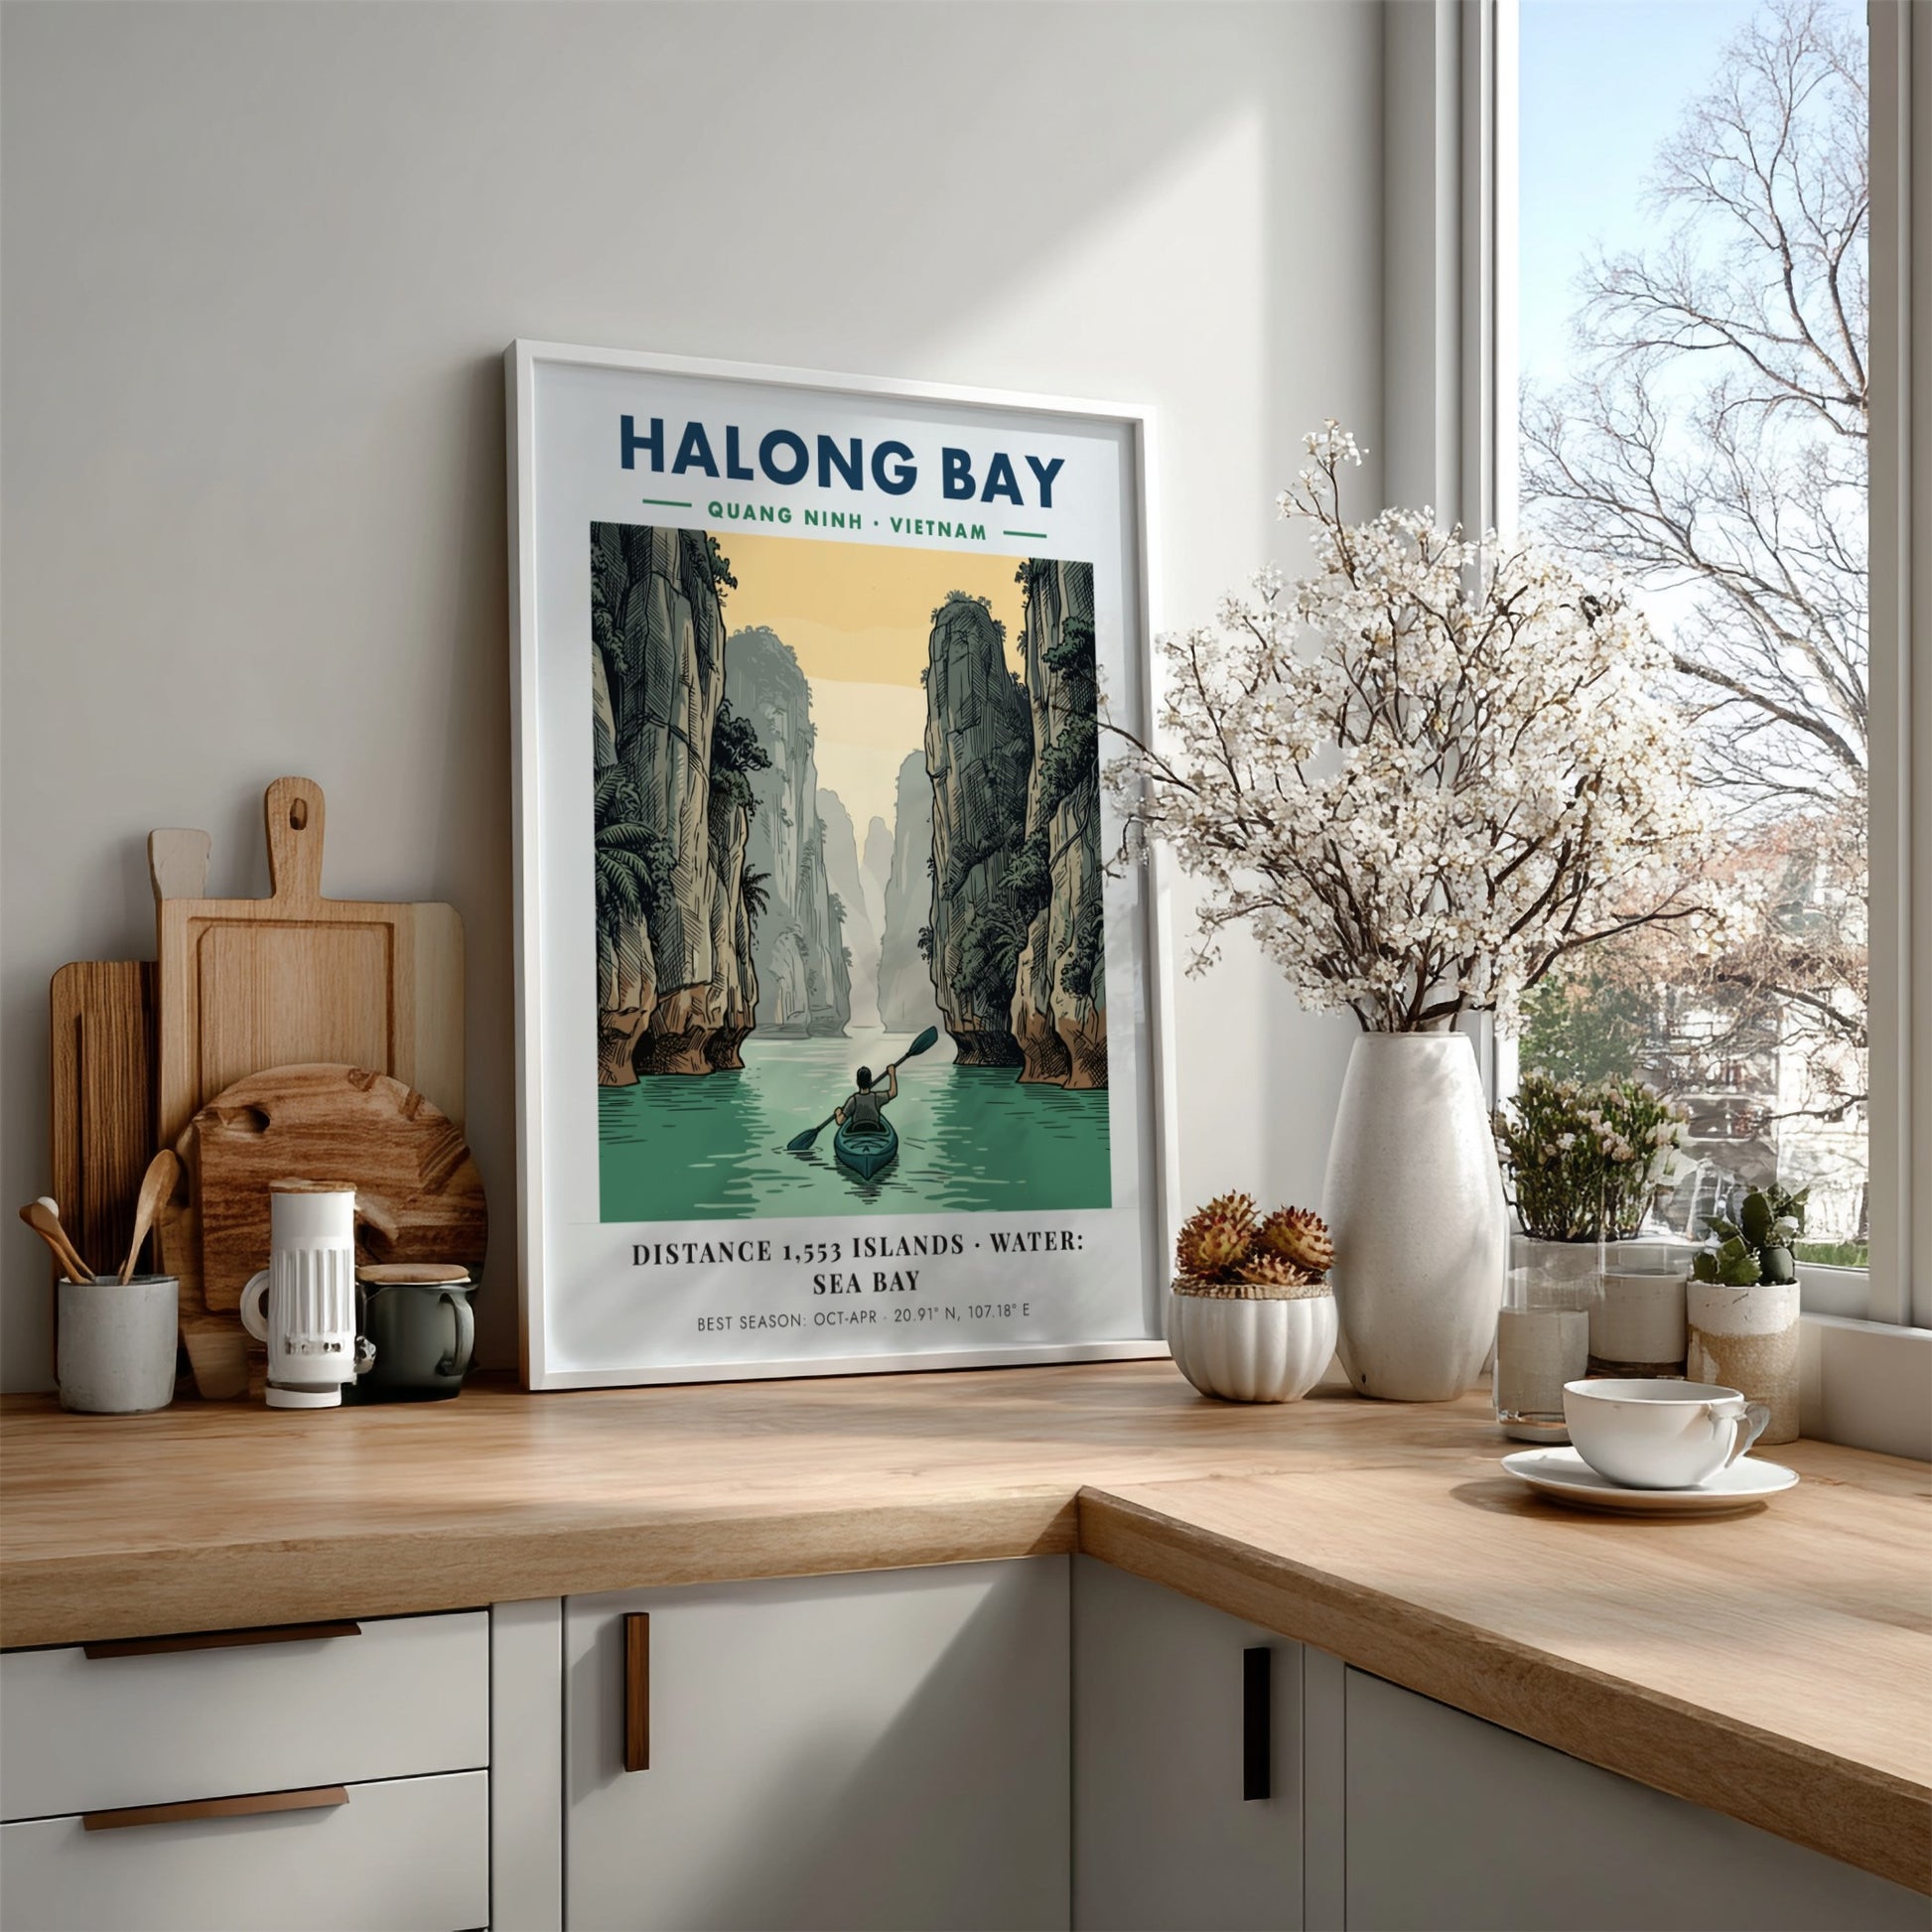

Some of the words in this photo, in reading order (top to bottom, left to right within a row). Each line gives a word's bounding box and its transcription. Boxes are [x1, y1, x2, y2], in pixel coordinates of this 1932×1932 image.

[620, 414, 917, 495] HALONG
[941, 447, 1065, 508] BAY
[708, 501, 791, 523] QUANG
[804, 509, 861, 529] NINH
[890, 516, 986, 540] VIETNAM
[632, 1240, 770, 1266] DISTANCE
[783, 1243, 841, 1264] 1,553
[853, 1234, 963, 1258] ISLANDS
[990, 1231, 1082, 1253] WATER:
[813, 1273, 862, 1295] SEA
[873, 1271, 919, 1293] BAY
[698, 1316, 733, 1331] BEST
[740, 1313, 806, 1329] SEASON:
[814, 1311, 877, 1326] OCT-APR
[895, 1308, 938, 1322] 20.91°
[945, 1307, 960, 1321] N,
[969, 1304, 1017, 1318] 107.18°
[1023, 1303, 1031, 1316] E
